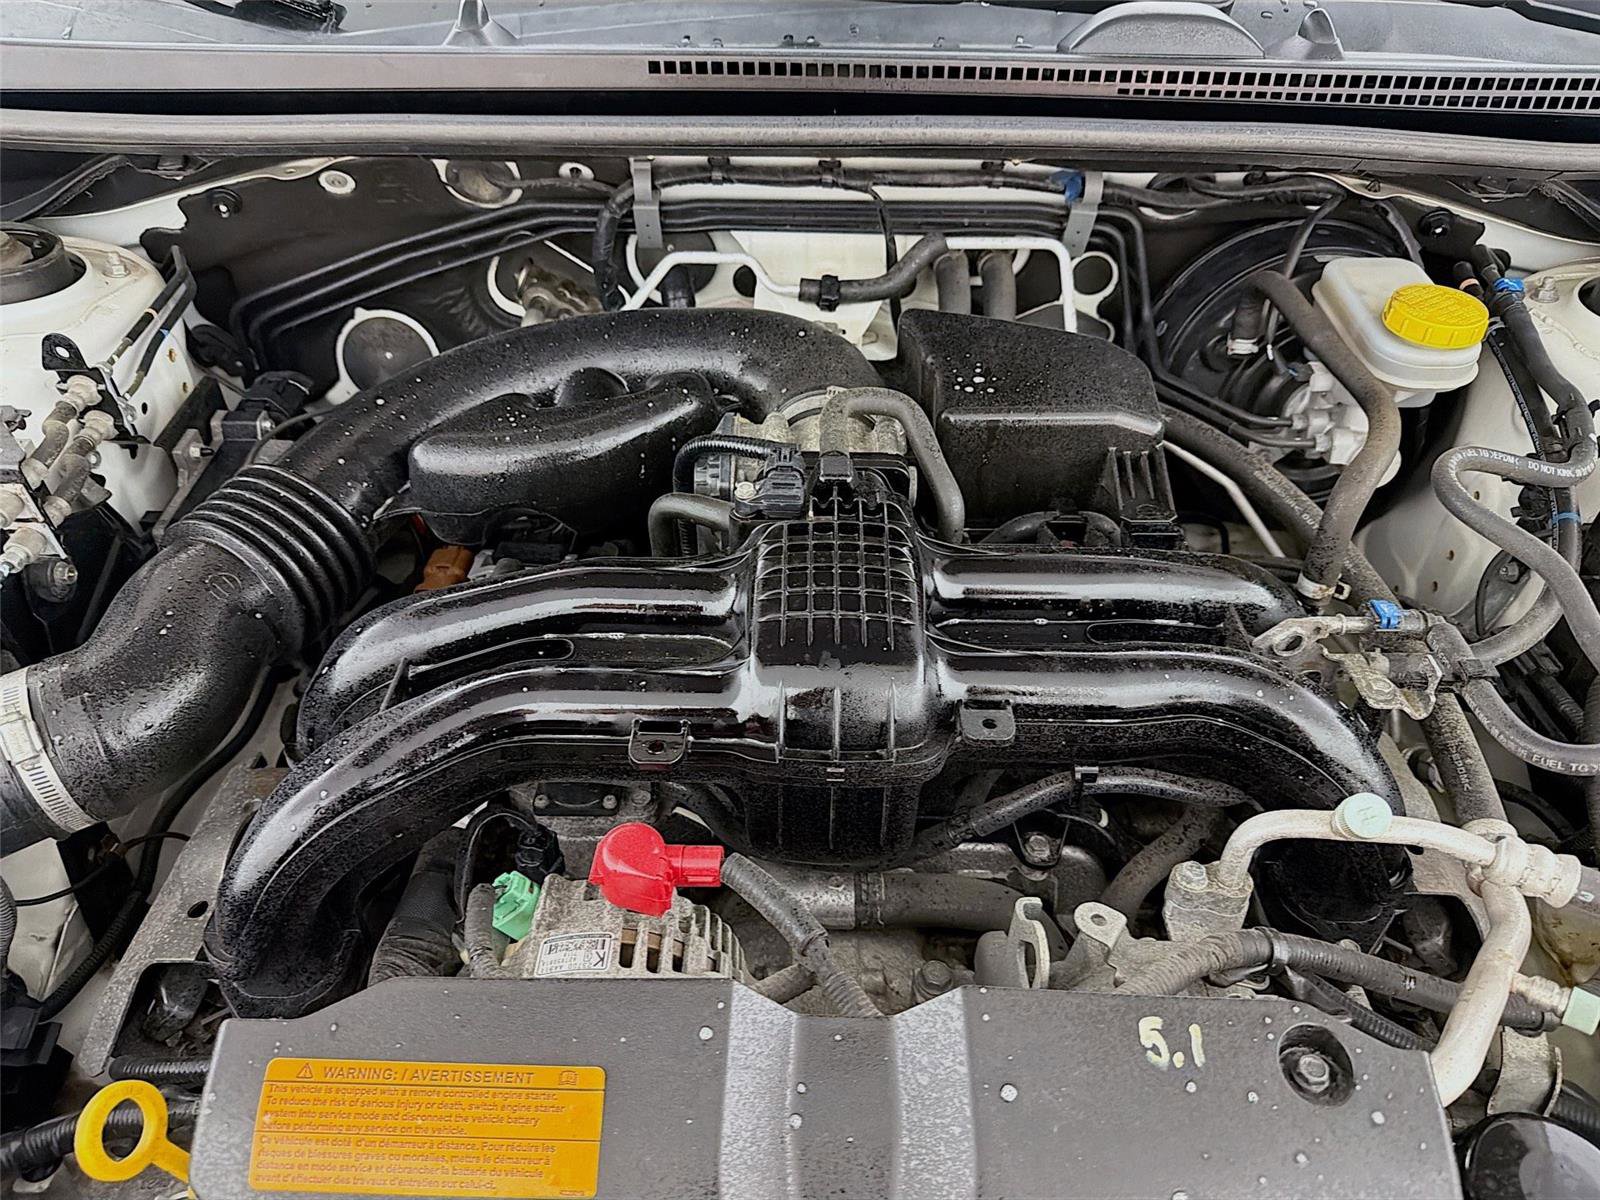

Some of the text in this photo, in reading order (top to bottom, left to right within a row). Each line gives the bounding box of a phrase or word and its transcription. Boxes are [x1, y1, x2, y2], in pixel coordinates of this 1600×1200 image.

[1528, 460, 1540, 471] DO
[1540, 464, 1555, 475] NOT
[1531, 754, 1566, 771] FUEL
[593, 951, 606, 968] K
[1138, 1016, 1206, 1071] 5.1
[322, 1067, 397, 1080] WARNING:
[410, 1069, 534, 1084] AVERTISSEMENT
